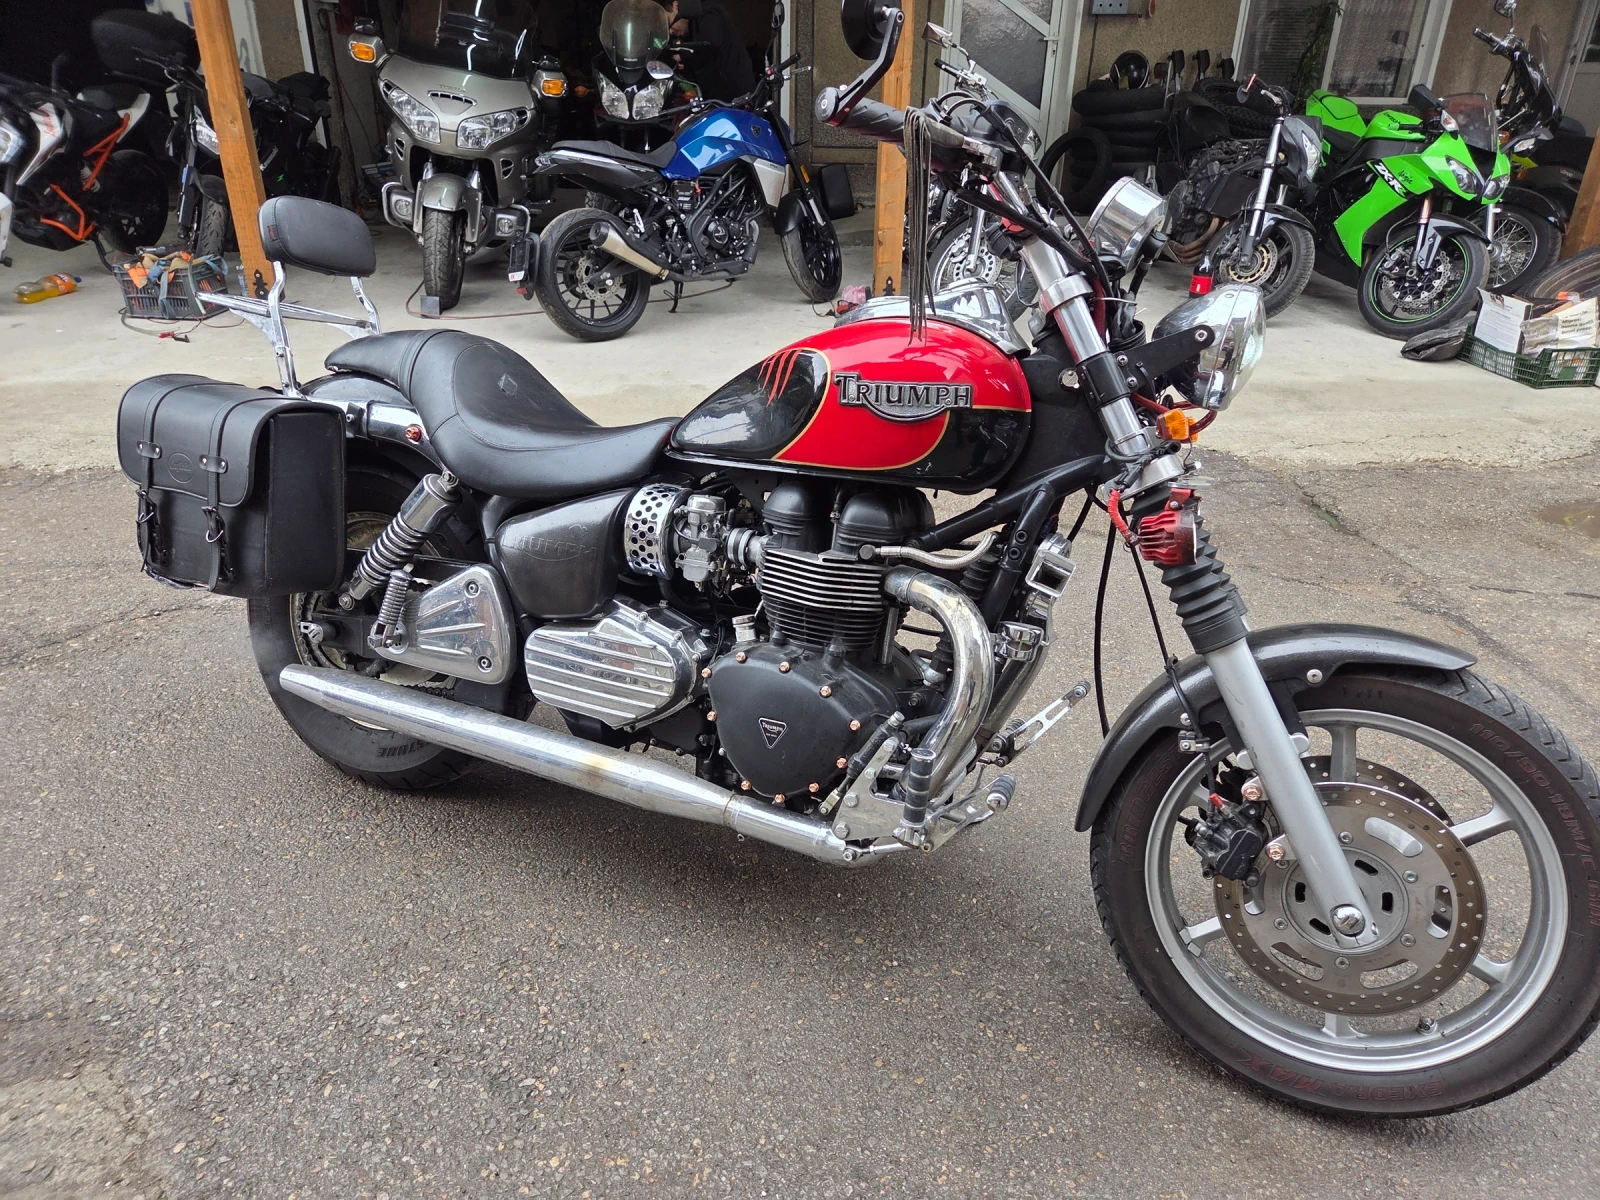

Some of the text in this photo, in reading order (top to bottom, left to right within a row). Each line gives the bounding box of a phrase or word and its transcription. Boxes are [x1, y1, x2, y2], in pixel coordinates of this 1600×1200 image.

[834, 373, 971, 409] TRIUMPH
[1237, 1055, 1443, 1100] EXEDRA MAX
